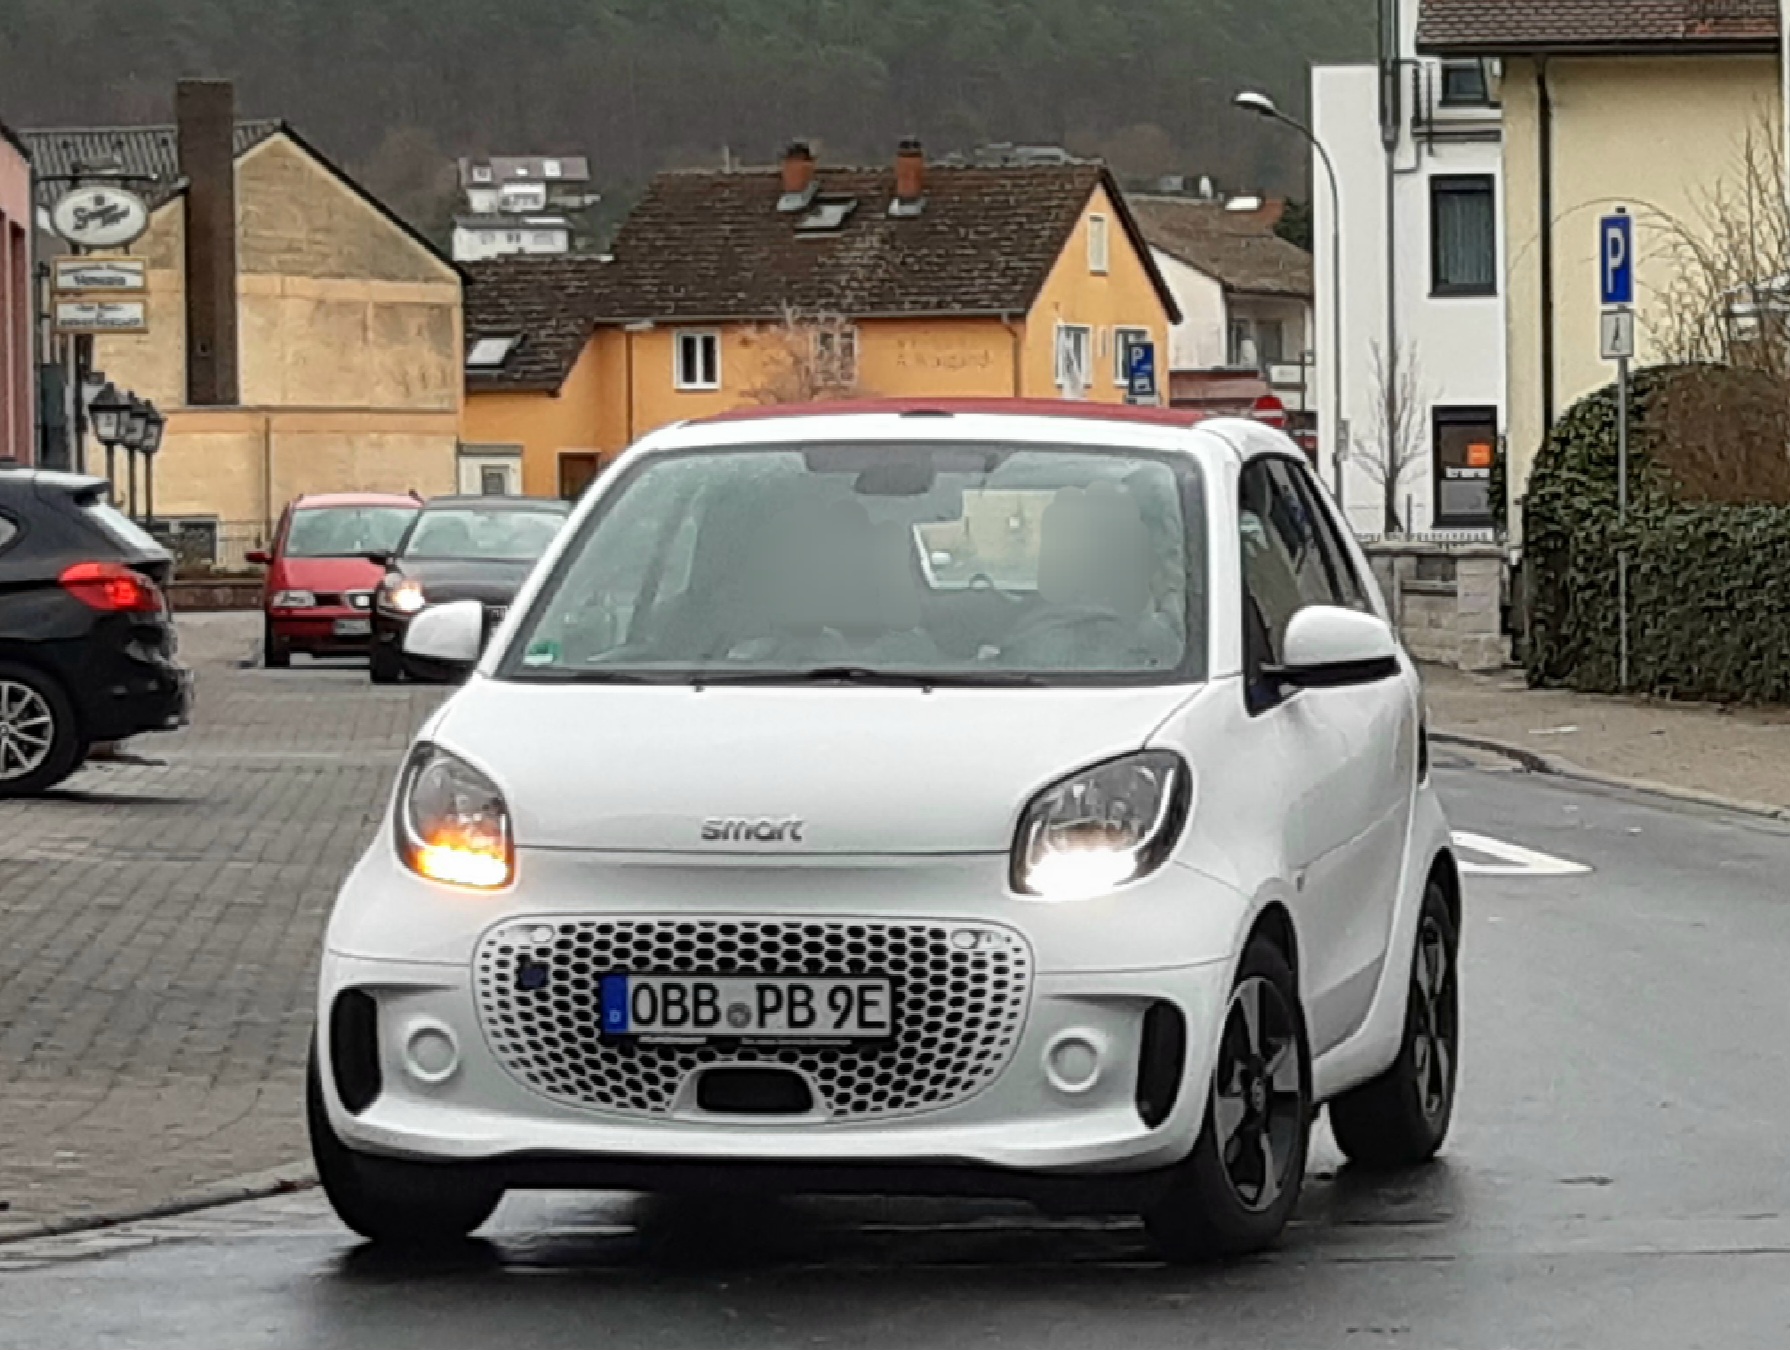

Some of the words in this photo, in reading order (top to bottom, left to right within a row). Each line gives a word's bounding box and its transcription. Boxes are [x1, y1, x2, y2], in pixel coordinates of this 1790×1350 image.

[1606, 227, 1625, 294] P
[1131, 346, 1145, 367] P
[700, 815, 805, 842] smart
[632, 982, 722, 1027] OBB
[754, 983, 818, 1029] PB
[827, 984, 888, 1030] 9E
